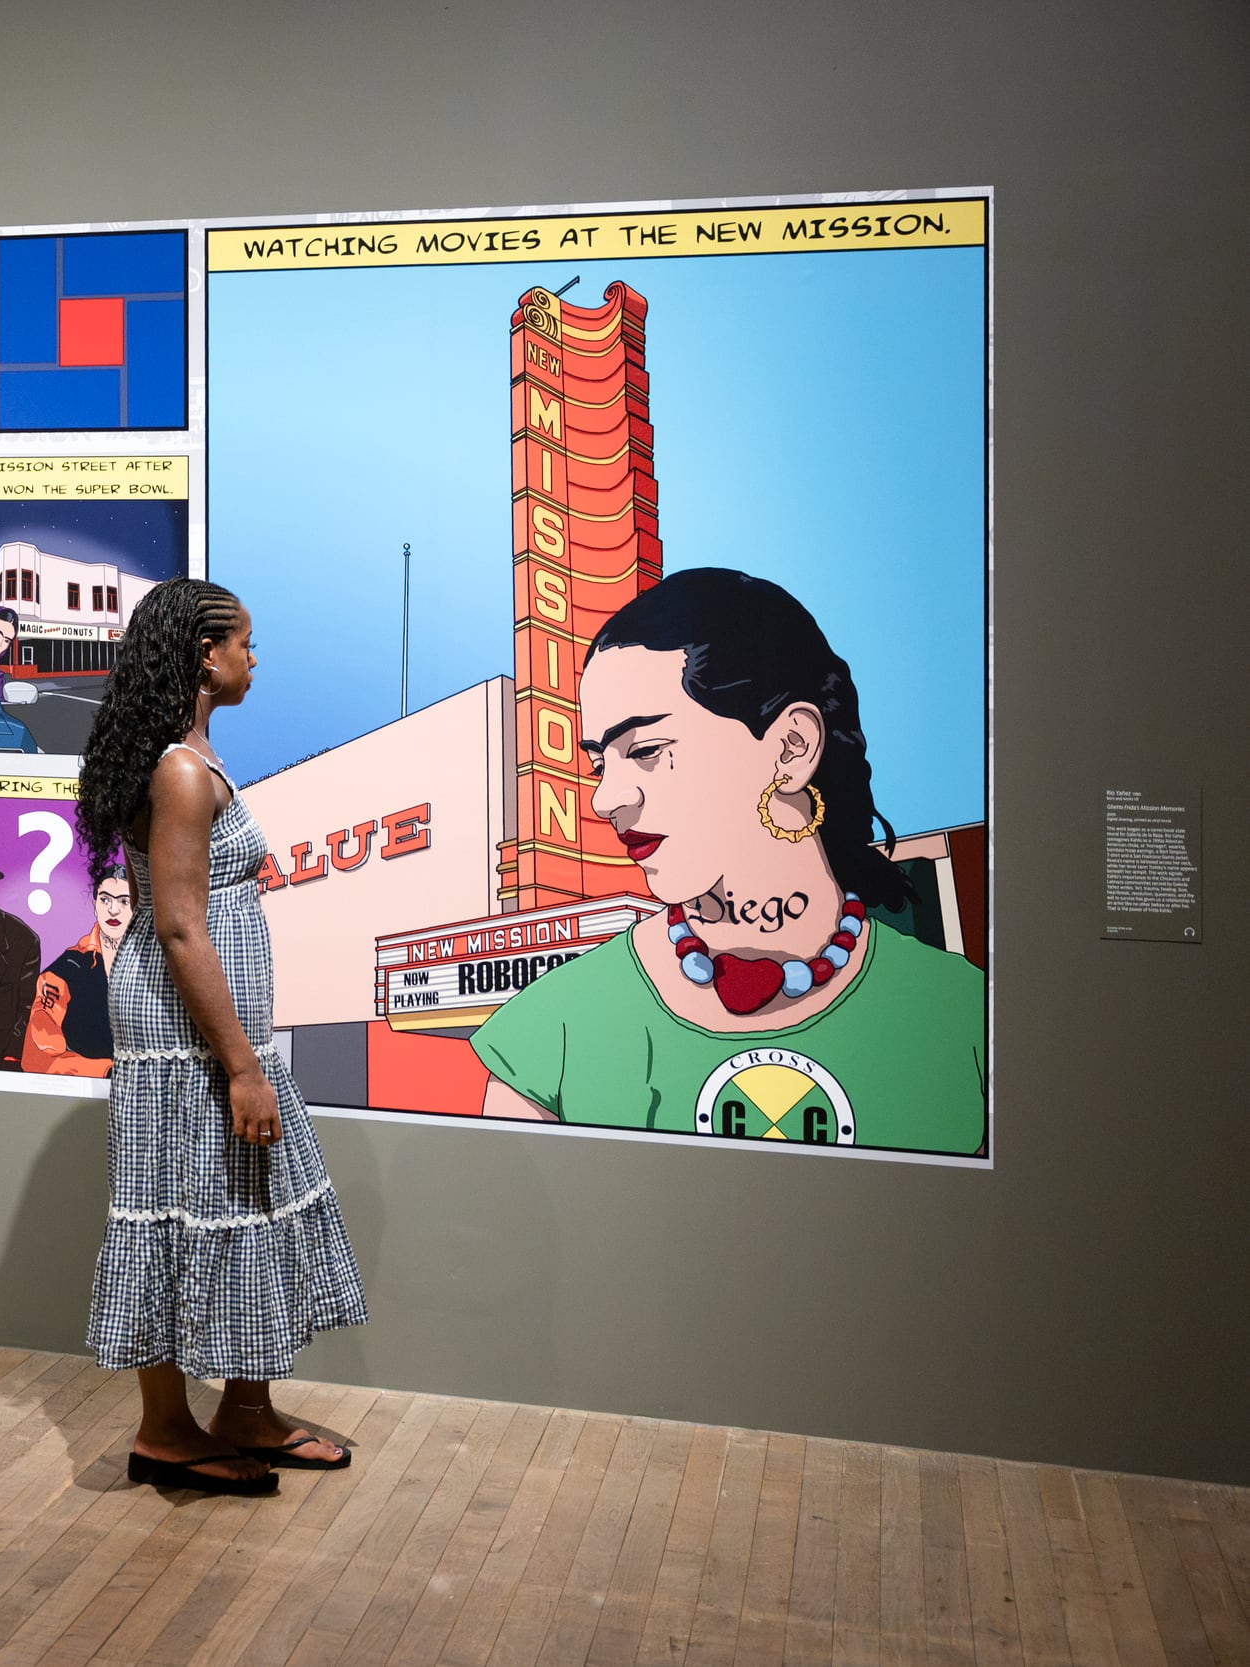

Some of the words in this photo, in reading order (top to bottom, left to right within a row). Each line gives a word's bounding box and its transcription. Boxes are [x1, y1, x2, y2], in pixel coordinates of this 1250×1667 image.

[244, 235, 398, 259] WATCHING
[416, 229, 541, 253] MOVIES
[559, 227, 599, 248] AT
[619, 224, 678, 246] THE
[696, 221, 763, 244] NEW
[782, 212, 951, 241] MISSION.
[527, 341, 561, 377] NEW
[61, 461, 117, 472] STREET
[126, 460, 173, 471] AFTER
[3, 485, 34, 494] WON
[44, 485, 68, 495] THE
[76, 484, 120, 494] SUPER
[129, 484, 174, 494] BOWL.
[530, 386, 577, 843] MISSION
[19, 624, 43, 635] MAGIC
[62, 627, 93, 637] DONUTS
[257, 802, 431, 894] ALUE
[412, 938, 454, 962] NEW
[467, 918, 572, 955] MISSION
[404, 971, 429, 986] NOW
[458, 953, 581, 995] ROBOC
[394, 992, 439, 1009] PLAYING
[729, 1050, 816, 1074] CROSS
